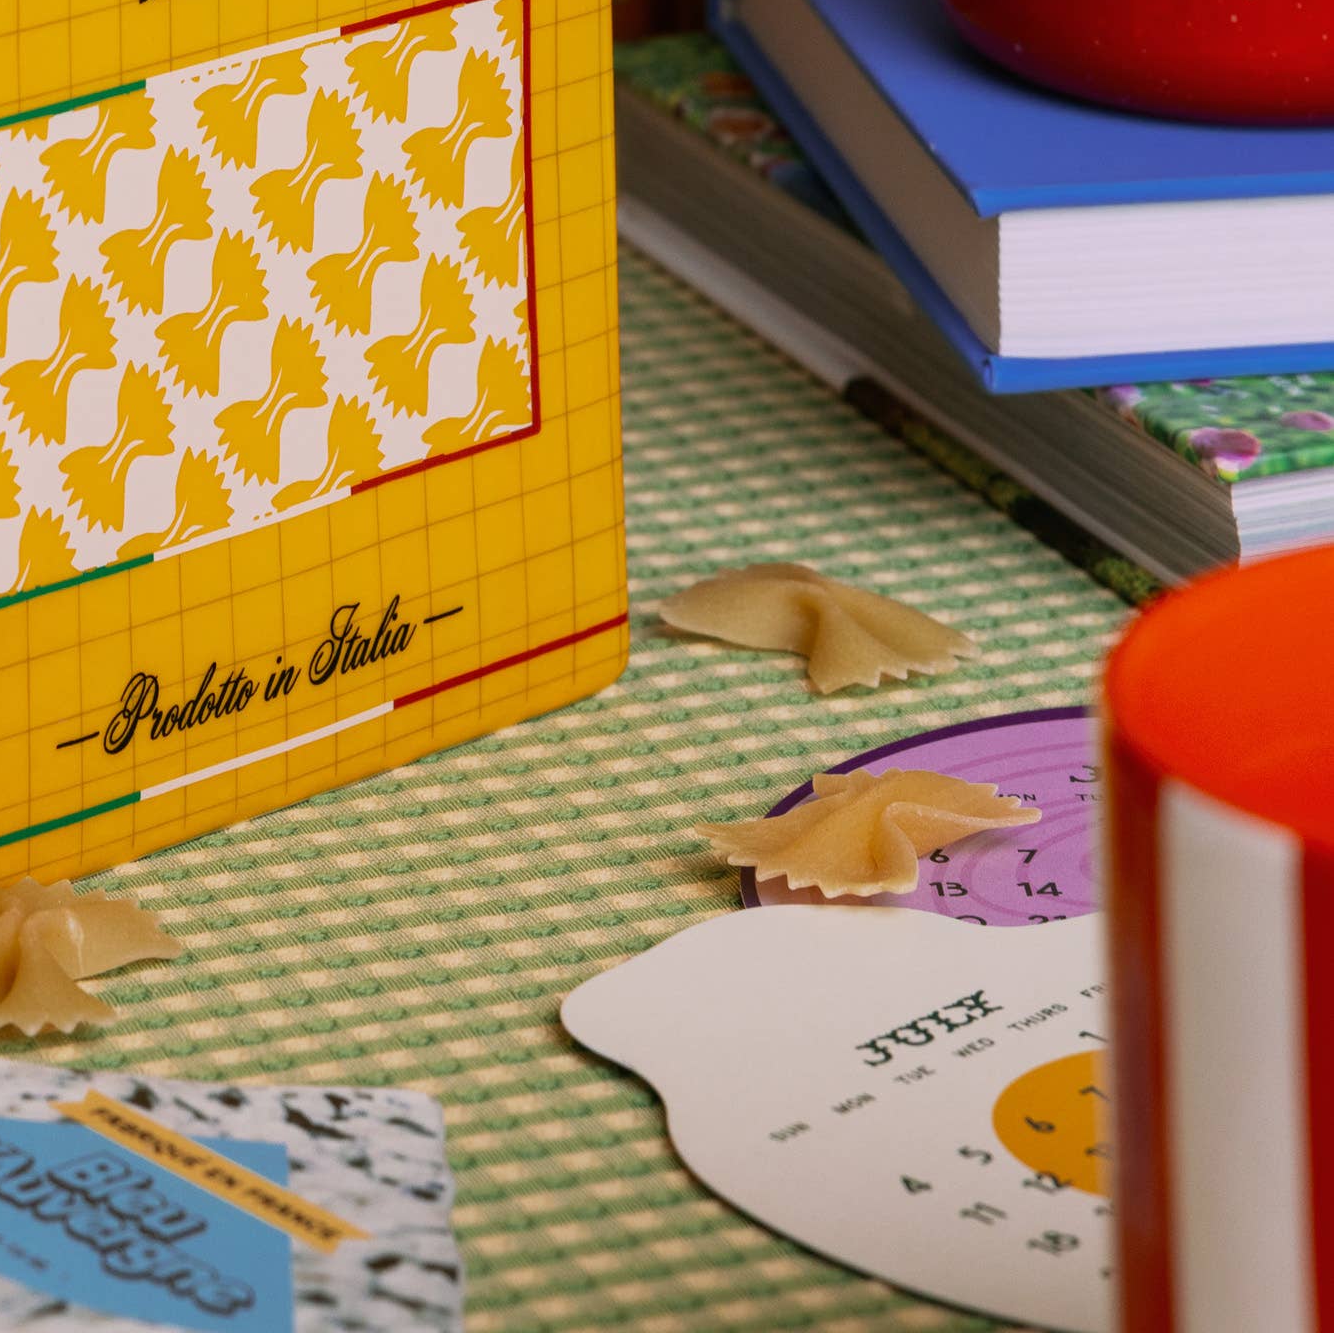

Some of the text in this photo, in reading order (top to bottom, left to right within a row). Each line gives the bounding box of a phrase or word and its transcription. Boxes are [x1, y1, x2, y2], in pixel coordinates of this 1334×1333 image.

[103, 594, 417, 755] Prodotto in Italia
[929, 848, 1039, 865] 6 7
[929, 882, 1063, 897] 13 14
[831, 1092, 877, 1115] MON
[893, 1064, 936, 1086] TUE
[952, 1036, 996, 1059] WED
[1007, 1002, 1068, 1033] THURS
[855, 989, 1005, 1068] JULY
[900, 1174, 934, 1196] 4
[958, 1145, 994, 1166] 5
[1024, 1116, 1056, 1134] 6
[1022, 1170, 1074, 1196] 12
[47, 1149, 208, 1246] Bleu
